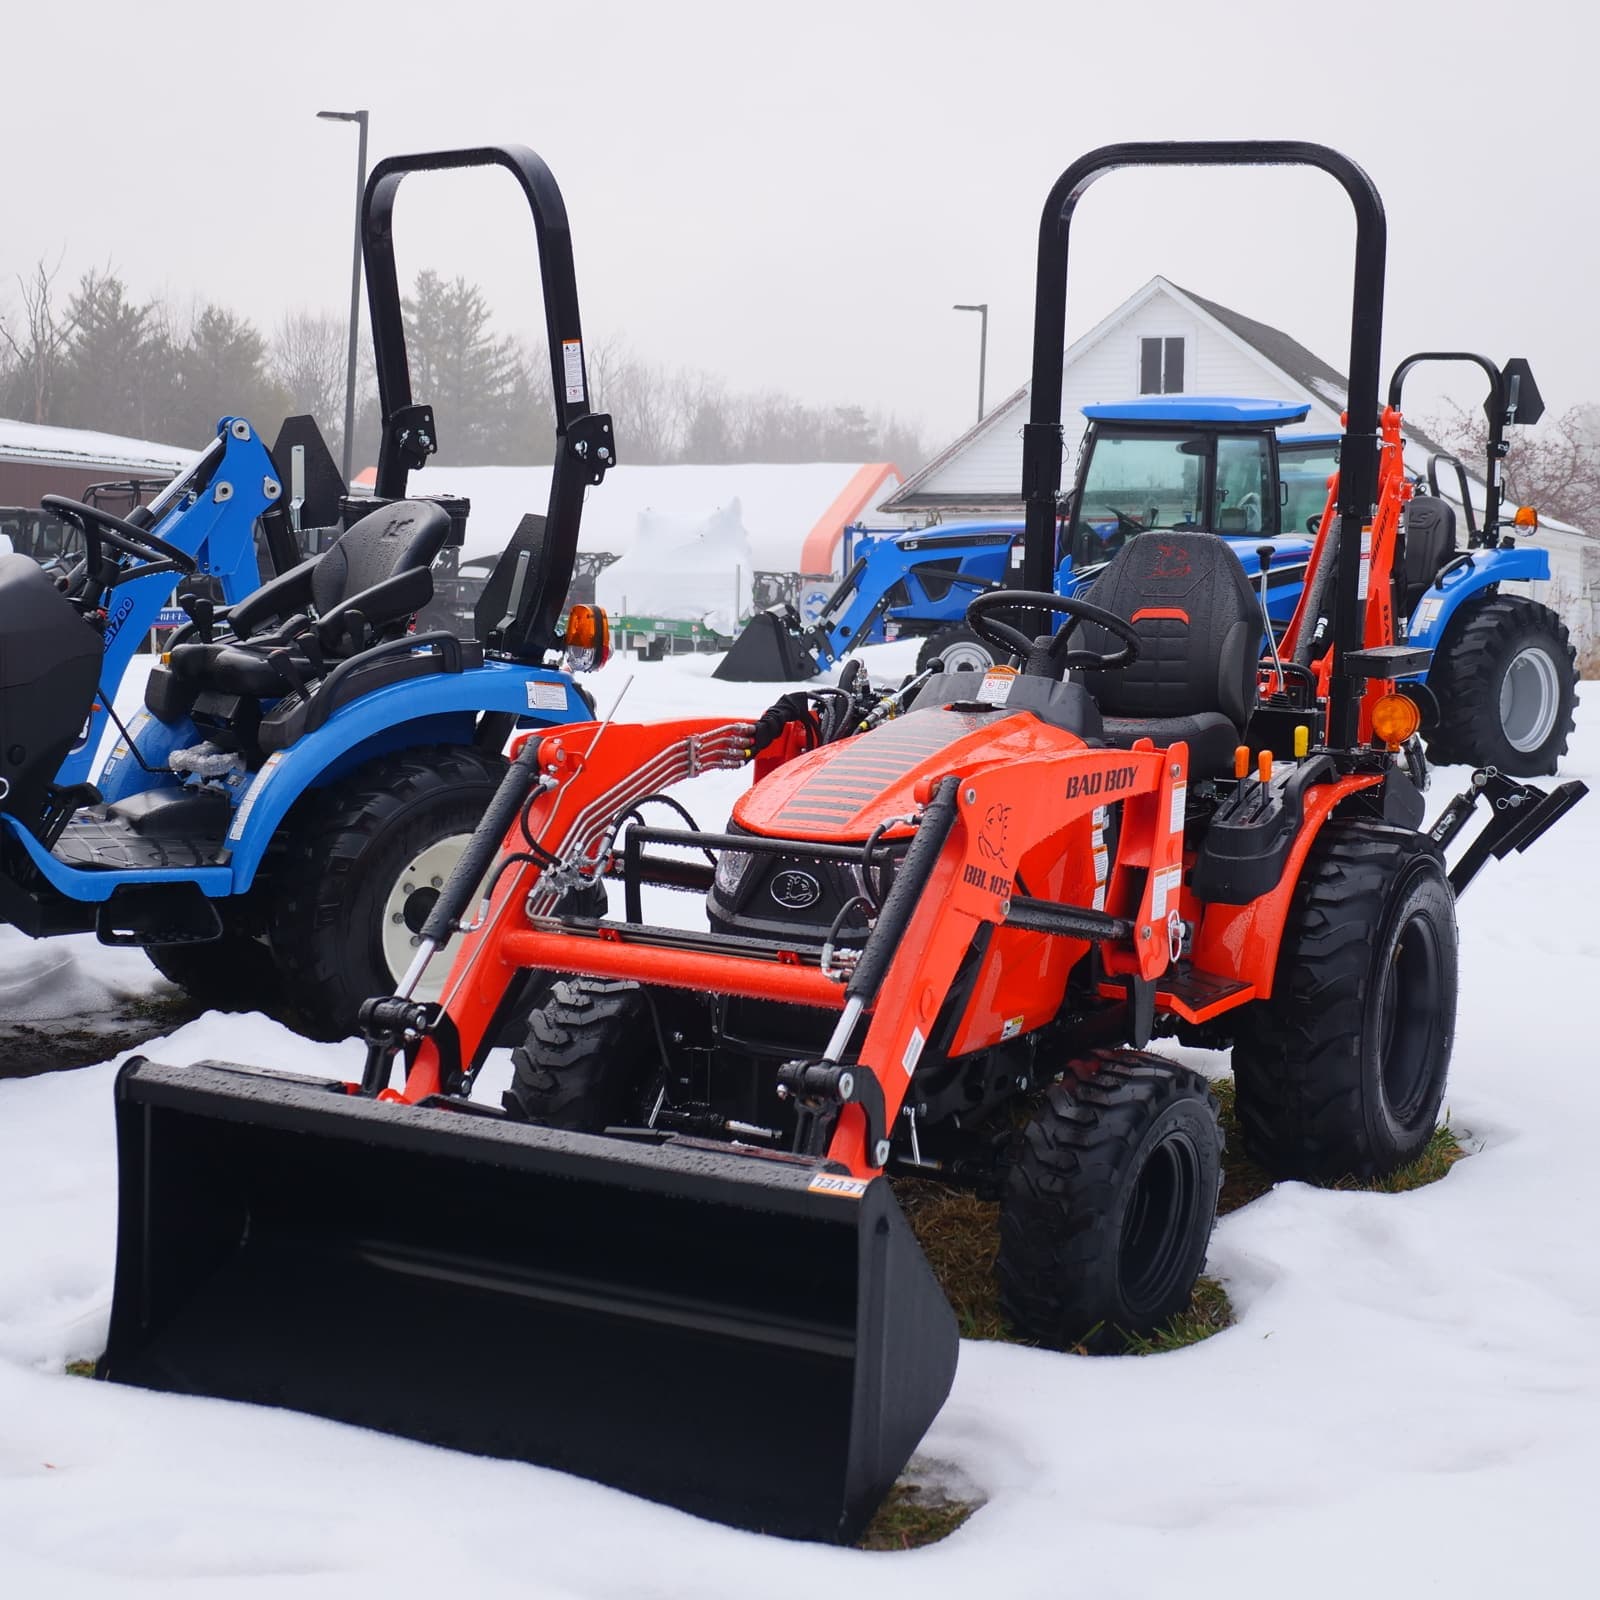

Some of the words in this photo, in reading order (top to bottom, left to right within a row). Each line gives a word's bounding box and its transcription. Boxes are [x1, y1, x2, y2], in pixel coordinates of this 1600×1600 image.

[903, 541, 918, 550] LS
[1066, 772, 1102, 799] BAD
[1104, 765, 1138, 792] BOY
[989, 875, 1011, 898] 105
[814, 1176, 867, 1194] LEVEL
